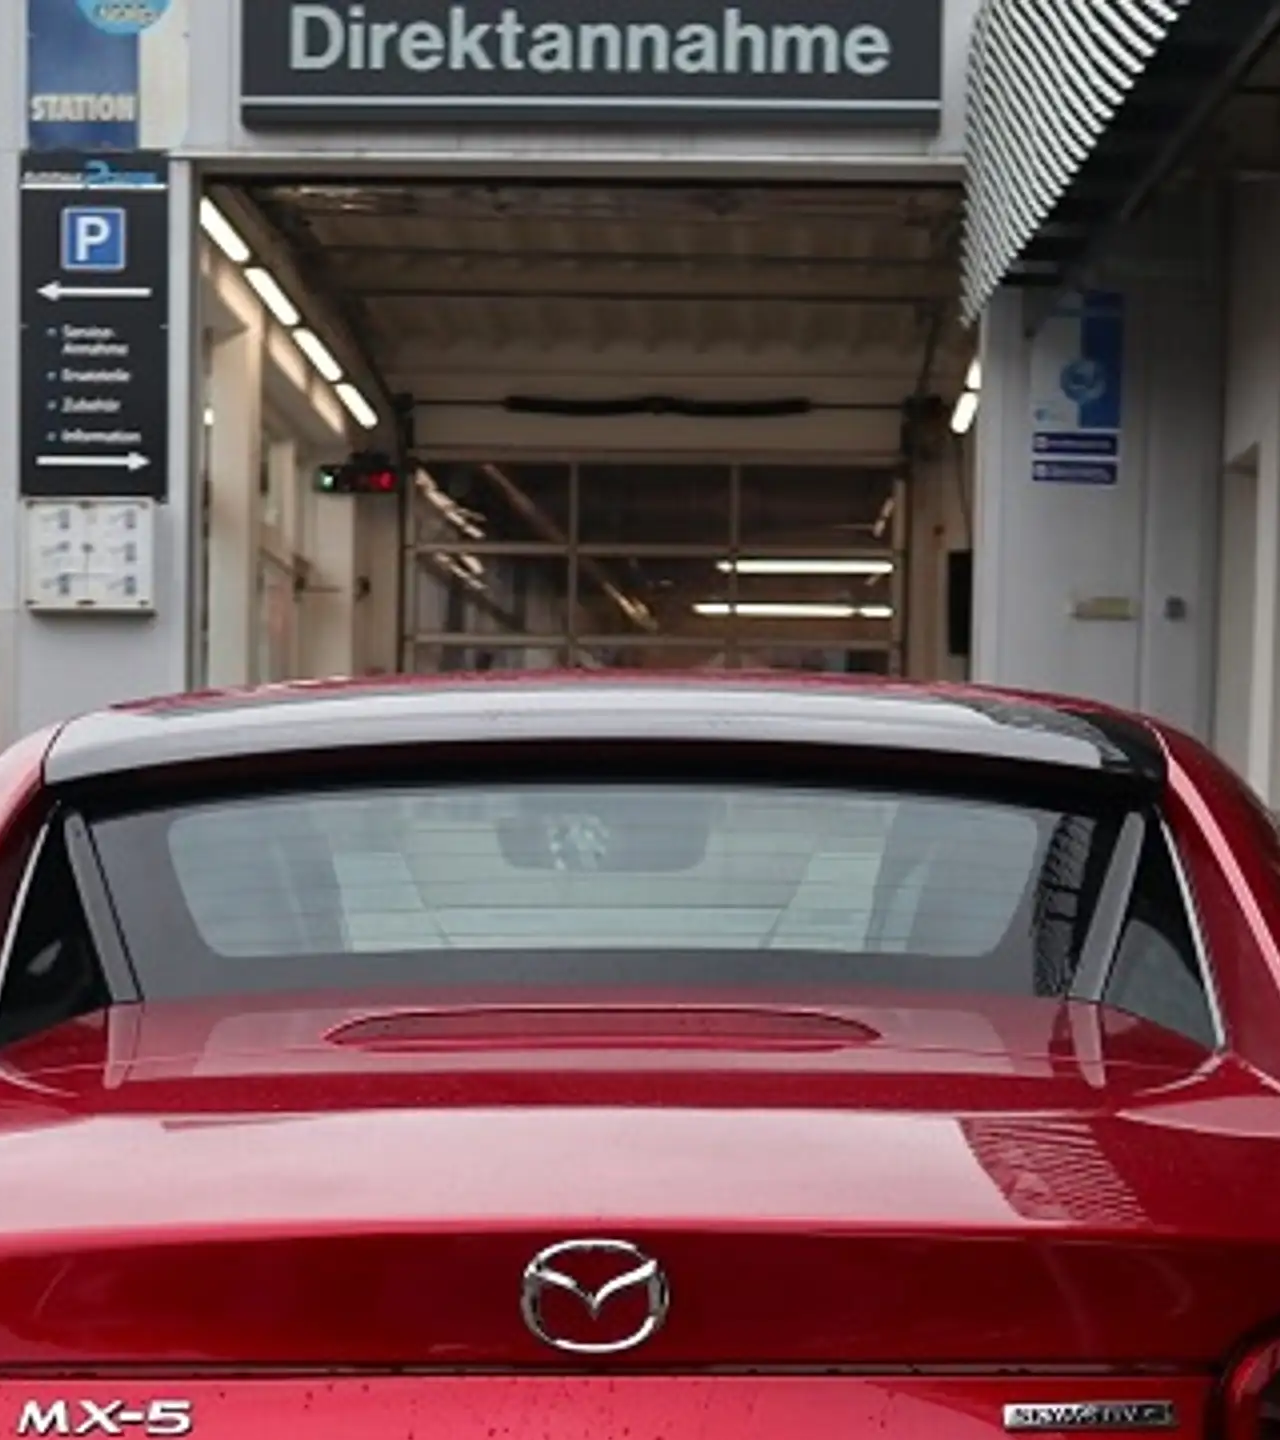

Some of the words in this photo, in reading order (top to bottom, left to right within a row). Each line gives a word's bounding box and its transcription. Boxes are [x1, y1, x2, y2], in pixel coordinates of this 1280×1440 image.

[289, 5, 891, 76] Direktannahme
[30, 94, 136, 122] STATION
[75, 215, 111, 262] P
[61, 428, 142, 444] Information
[17, 1399, 192, 1436] MX-5
